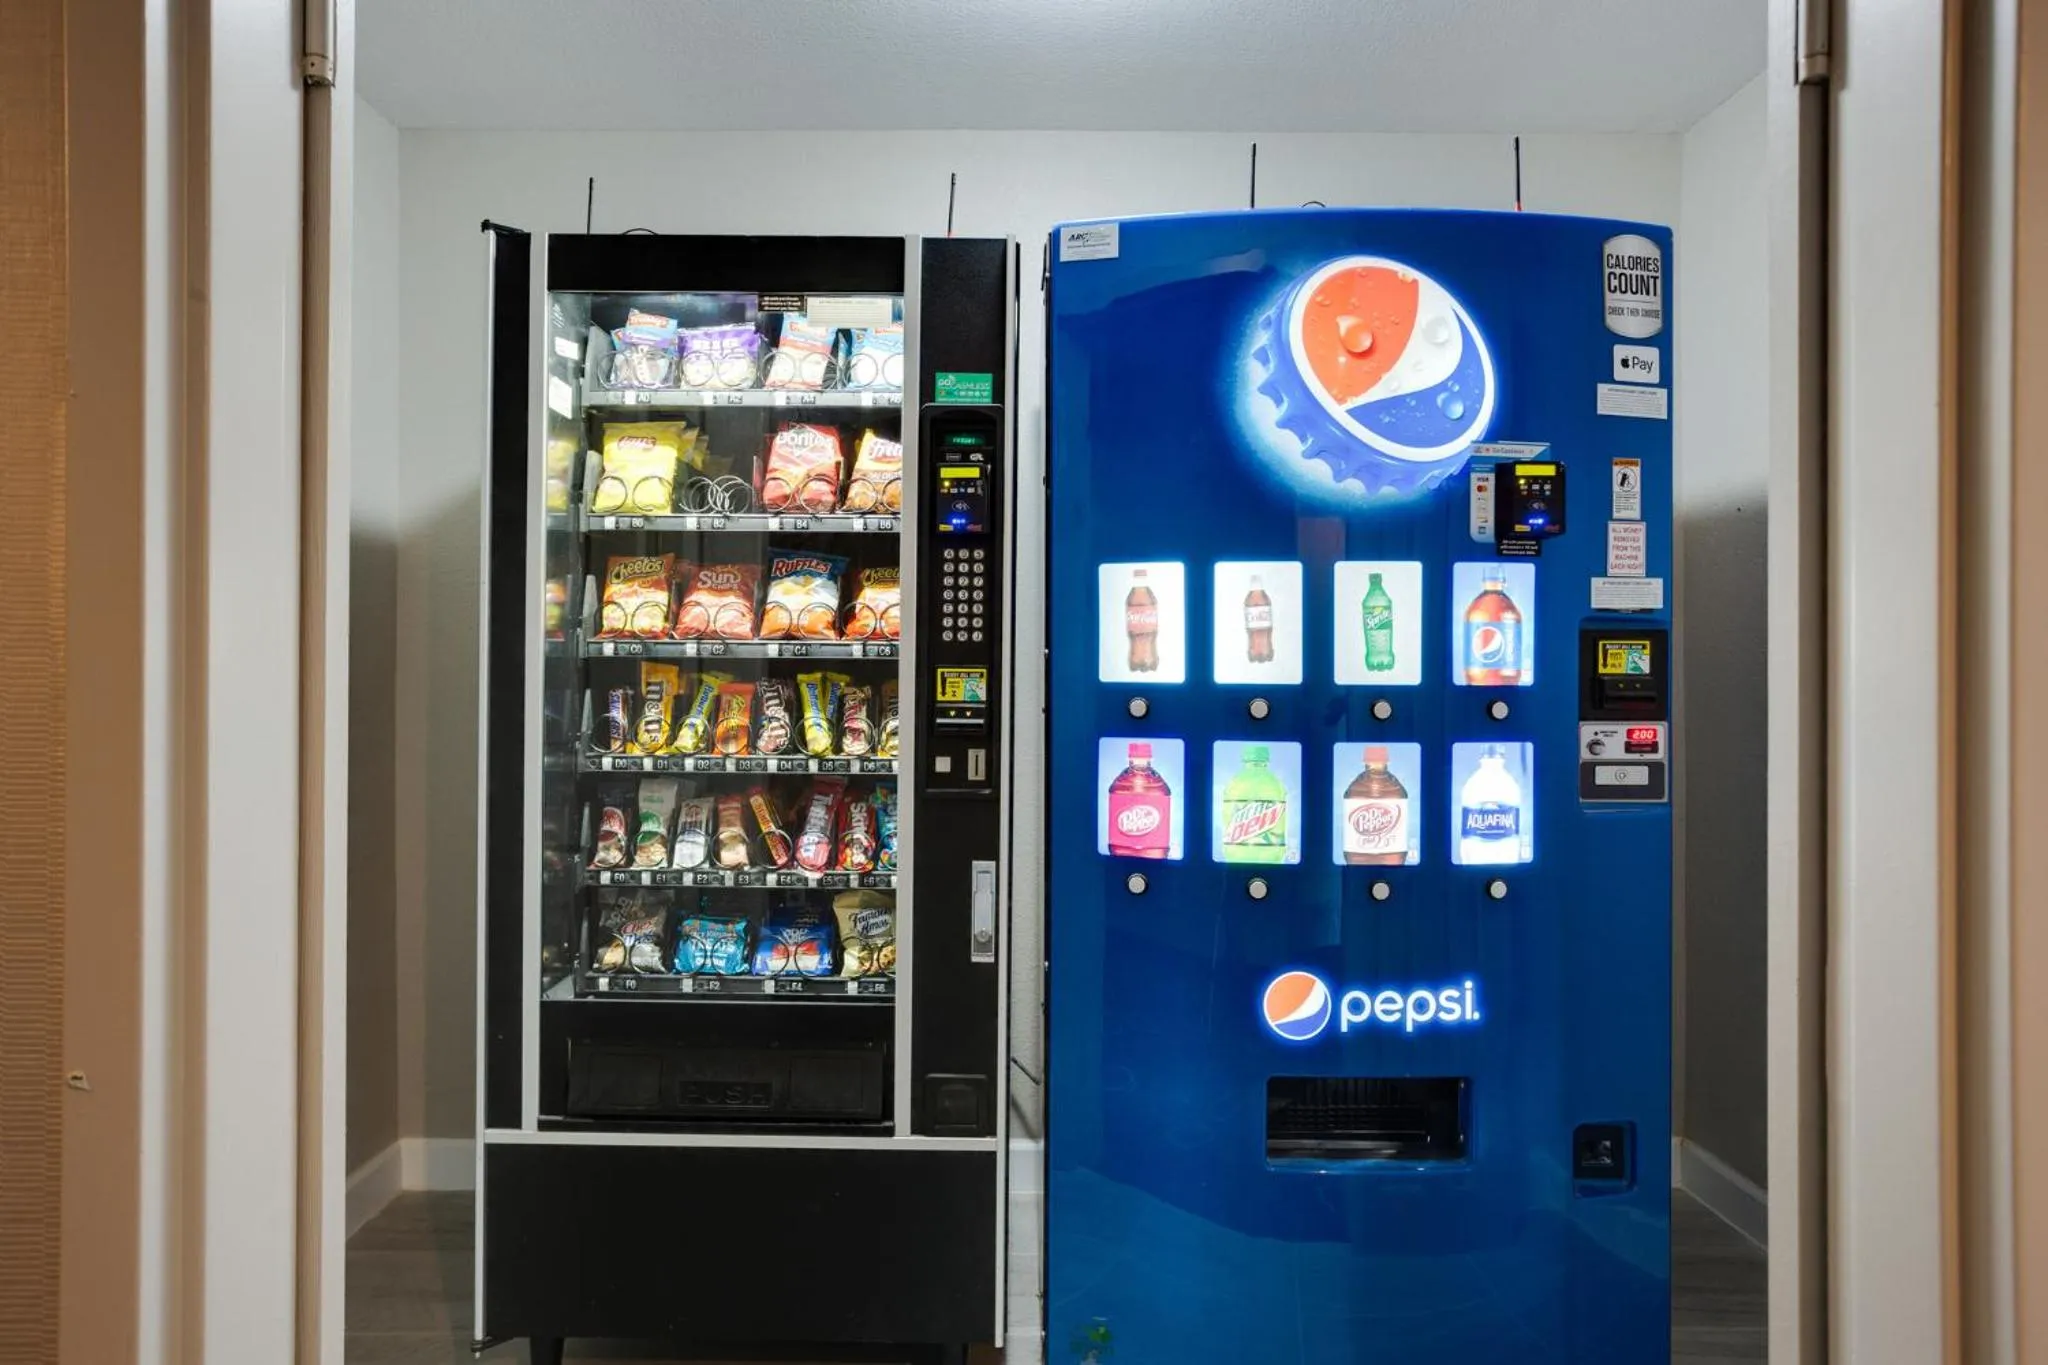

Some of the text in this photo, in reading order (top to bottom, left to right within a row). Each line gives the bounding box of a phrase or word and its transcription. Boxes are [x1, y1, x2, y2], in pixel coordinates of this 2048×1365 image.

[1606, 253, 1660, 274] CALORIES
[1607, 271, 1660, 298] COUNT
[1607, 305, 1625, 316] CHECK
[1632, 356, 1654, 374] Pay
[779, 431, 833, 448] Doritos
[713, 518, 725, 528] B2
[796, 519, 808, 528] B4
[610, 558, 665, 585] Cheetos
[698, 570, 741, 589] Sun
[1365, 610, 1394, 630] Sprite
[712, 644, 724, 654] C2
[794, 646, 806, 655] C4
[878, 646, 891, 656] C6
[615, 759, 627, 769] D0
[657, 759, 668, 769] D1
[697, 760, 710, 769] D2
[739, 760, 751, 770] D3
[780, 760, 792, 770] D4
[822, 761, 833, 770] D5
[863, 761, 875, 770] D6
[1355, 810, 1393, 832] Pepper
[1466, 813, 1516, 830] AQUAFINA
[656, 873, 666, 882] E1
[696, 874, 708, 883] E2
[738, 874, 749, 883] E3
[780, 874, 791, 884] E4
[822, 875, 832, 885] E5
[848, 908, 889, 928] Famous
[860, 919, 889, 937] Amos
[709, 980, 721, 990] F2
